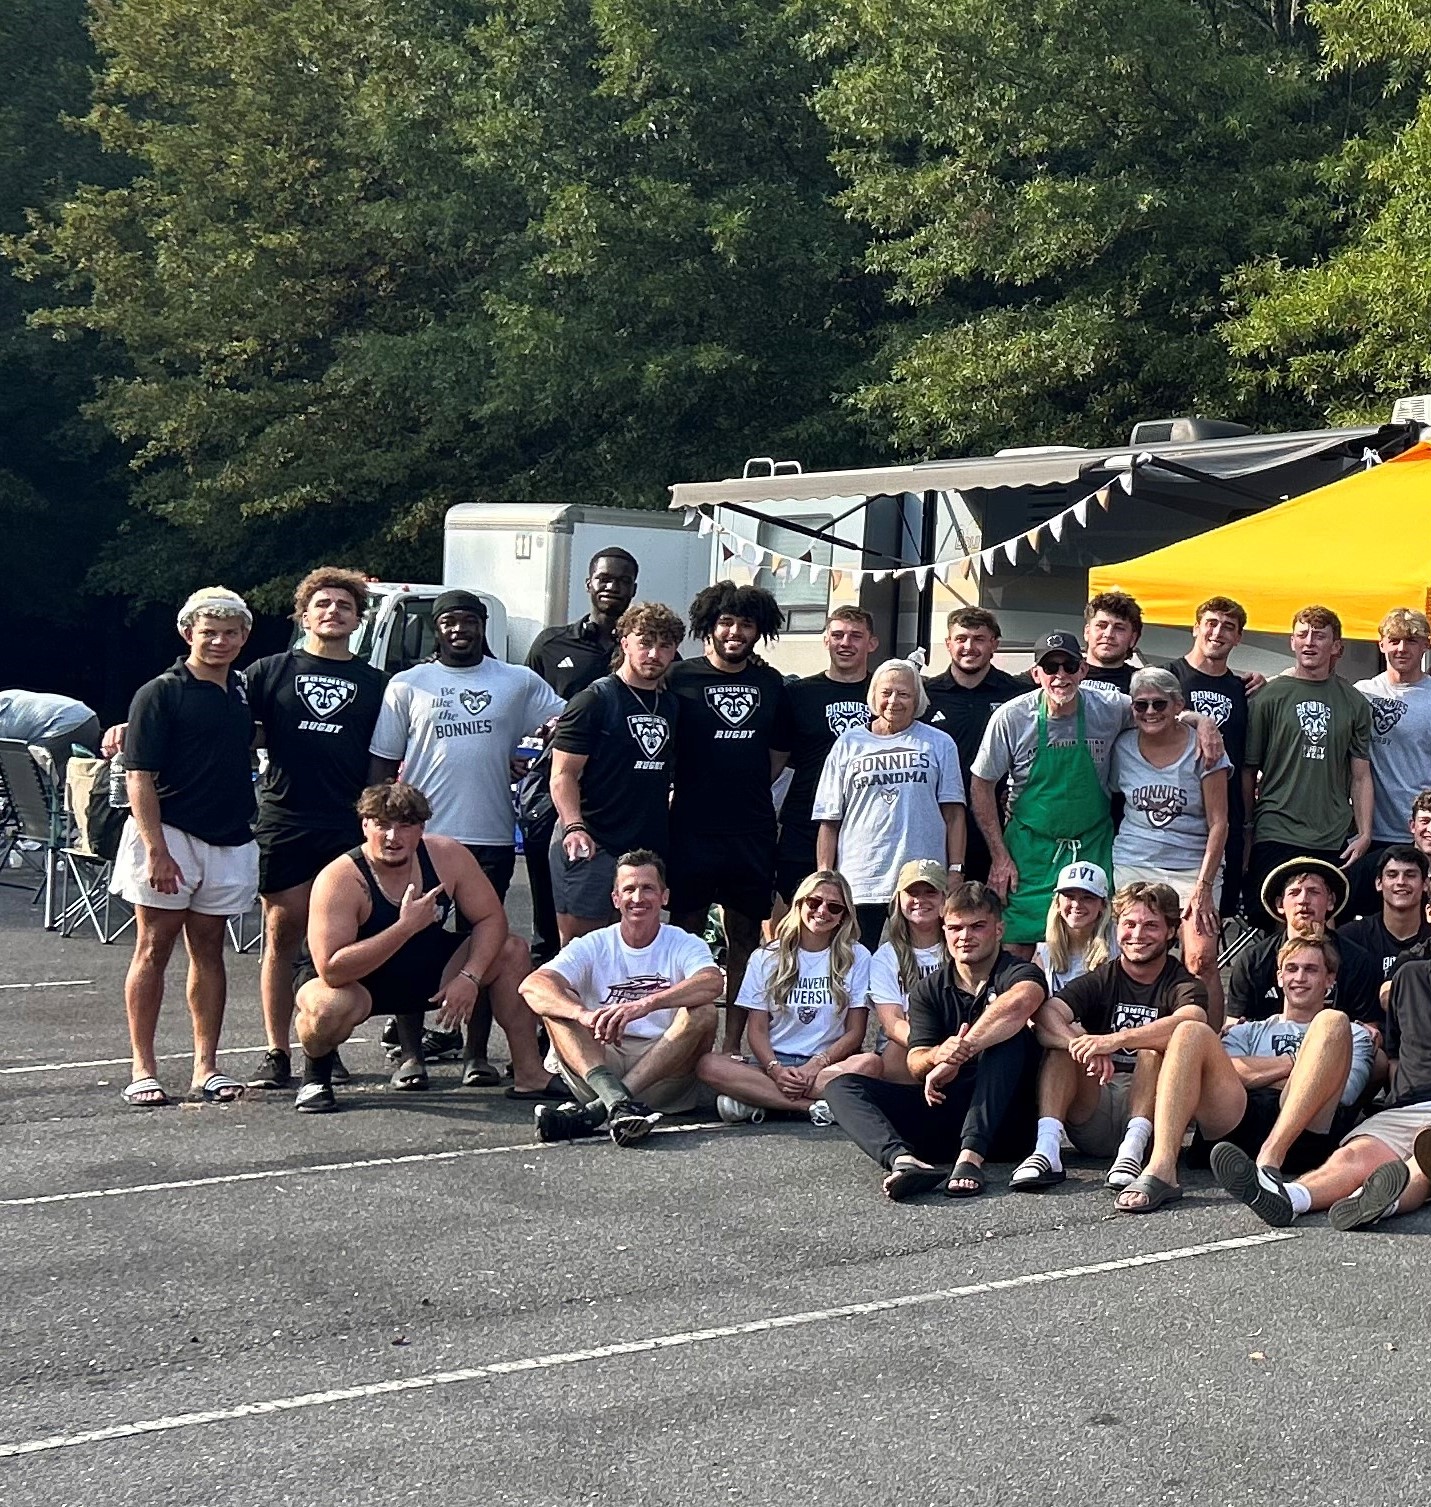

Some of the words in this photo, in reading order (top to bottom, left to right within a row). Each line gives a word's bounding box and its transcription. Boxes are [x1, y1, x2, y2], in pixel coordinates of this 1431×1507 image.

[440, 687, 456, 697] Be
[438, 709, 459, 722] the
[826, 702, 872, 718] BONNIES
[298, 720, 343, 734] RUGBY
[435, 719, 492, 739] BONNIES
[714, 730, 756, 739] RUGBY
[851, 752, 930, 774] BONNIES
[854, 770, 928, 790] GRANDMA
[1132, 784, 1188, 806] BONNIES
[1068, 868, 1095, 882] BVI
